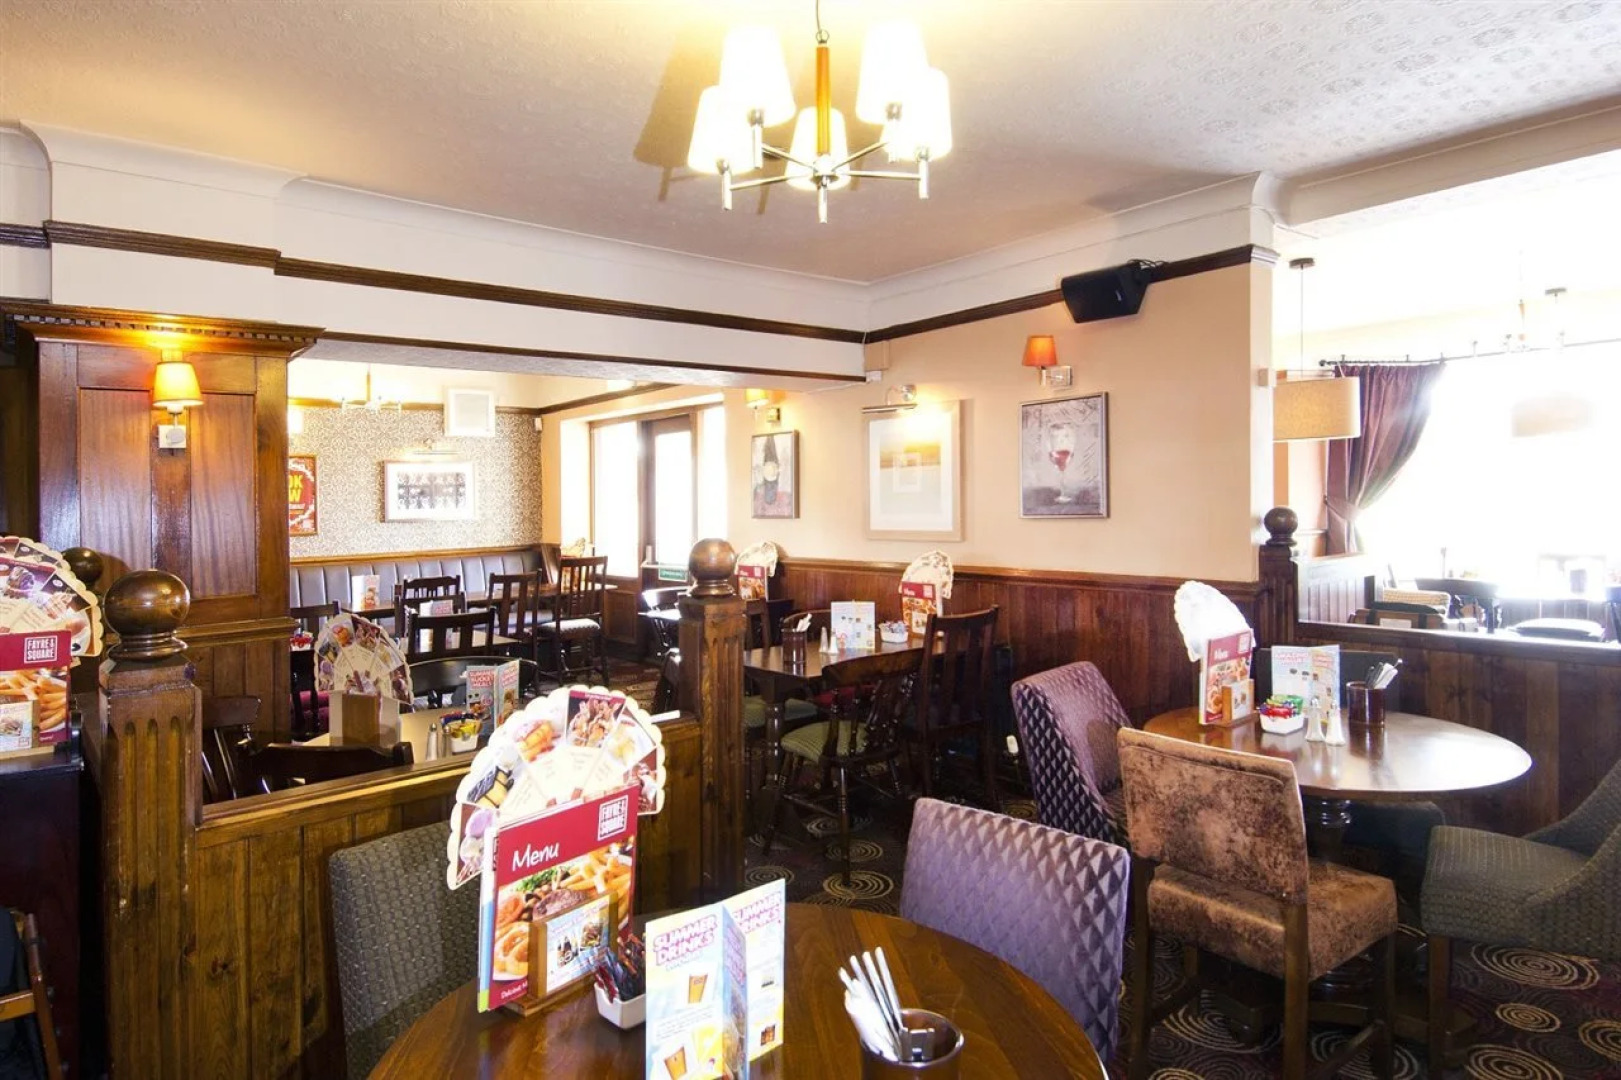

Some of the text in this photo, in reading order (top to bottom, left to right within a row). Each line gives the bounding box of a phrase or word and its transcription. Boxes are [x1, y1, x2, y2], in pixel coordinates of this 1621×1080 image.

[27, 648, 54, 661] SQUARE
[512, 842, 559, 871] Menu
[653, 914, 717, 952] SUMMER
[656, 930, 715, 966] DRINKS
